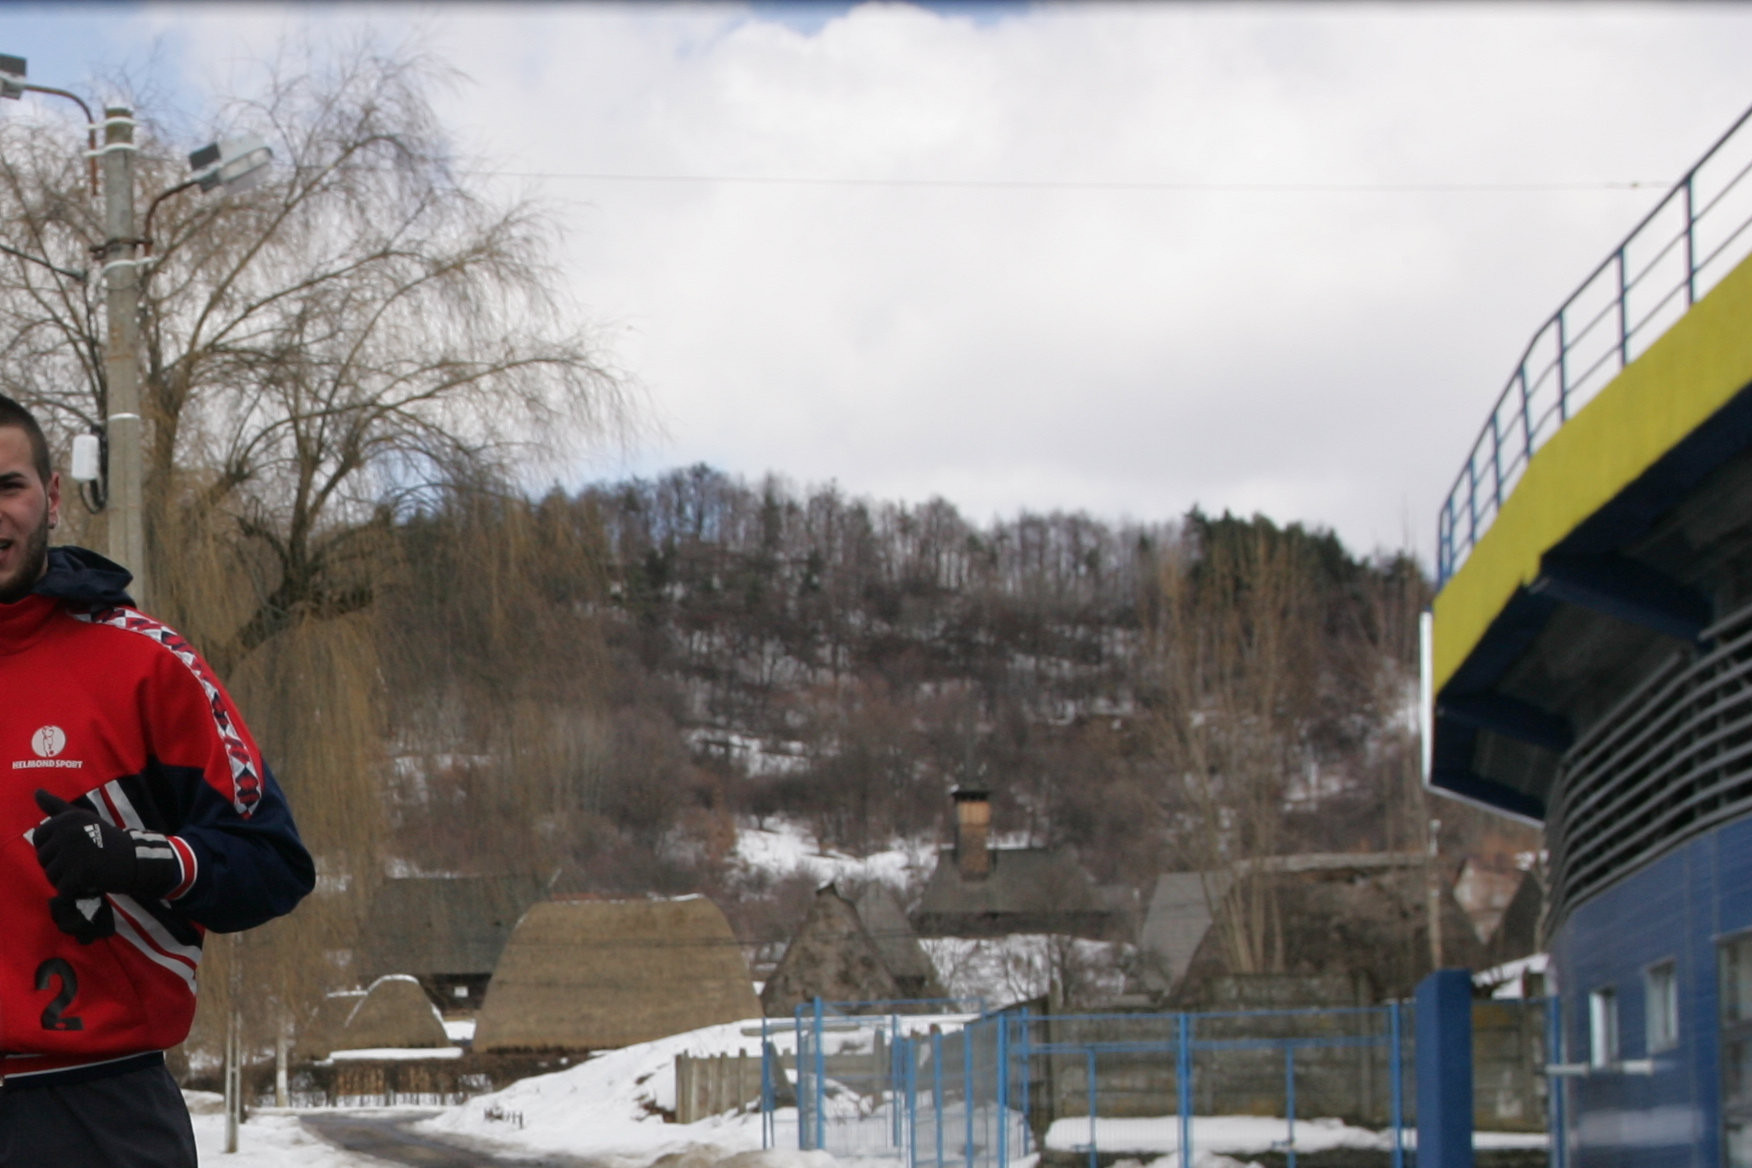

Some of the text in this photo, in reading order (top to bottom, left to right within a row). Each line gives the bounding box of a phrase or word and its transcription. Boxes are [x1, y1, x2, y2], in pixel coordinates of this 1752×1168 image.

[11, 759, 84, 770] HELMOND SPORT
[34, 957, 84, 1031] 2
